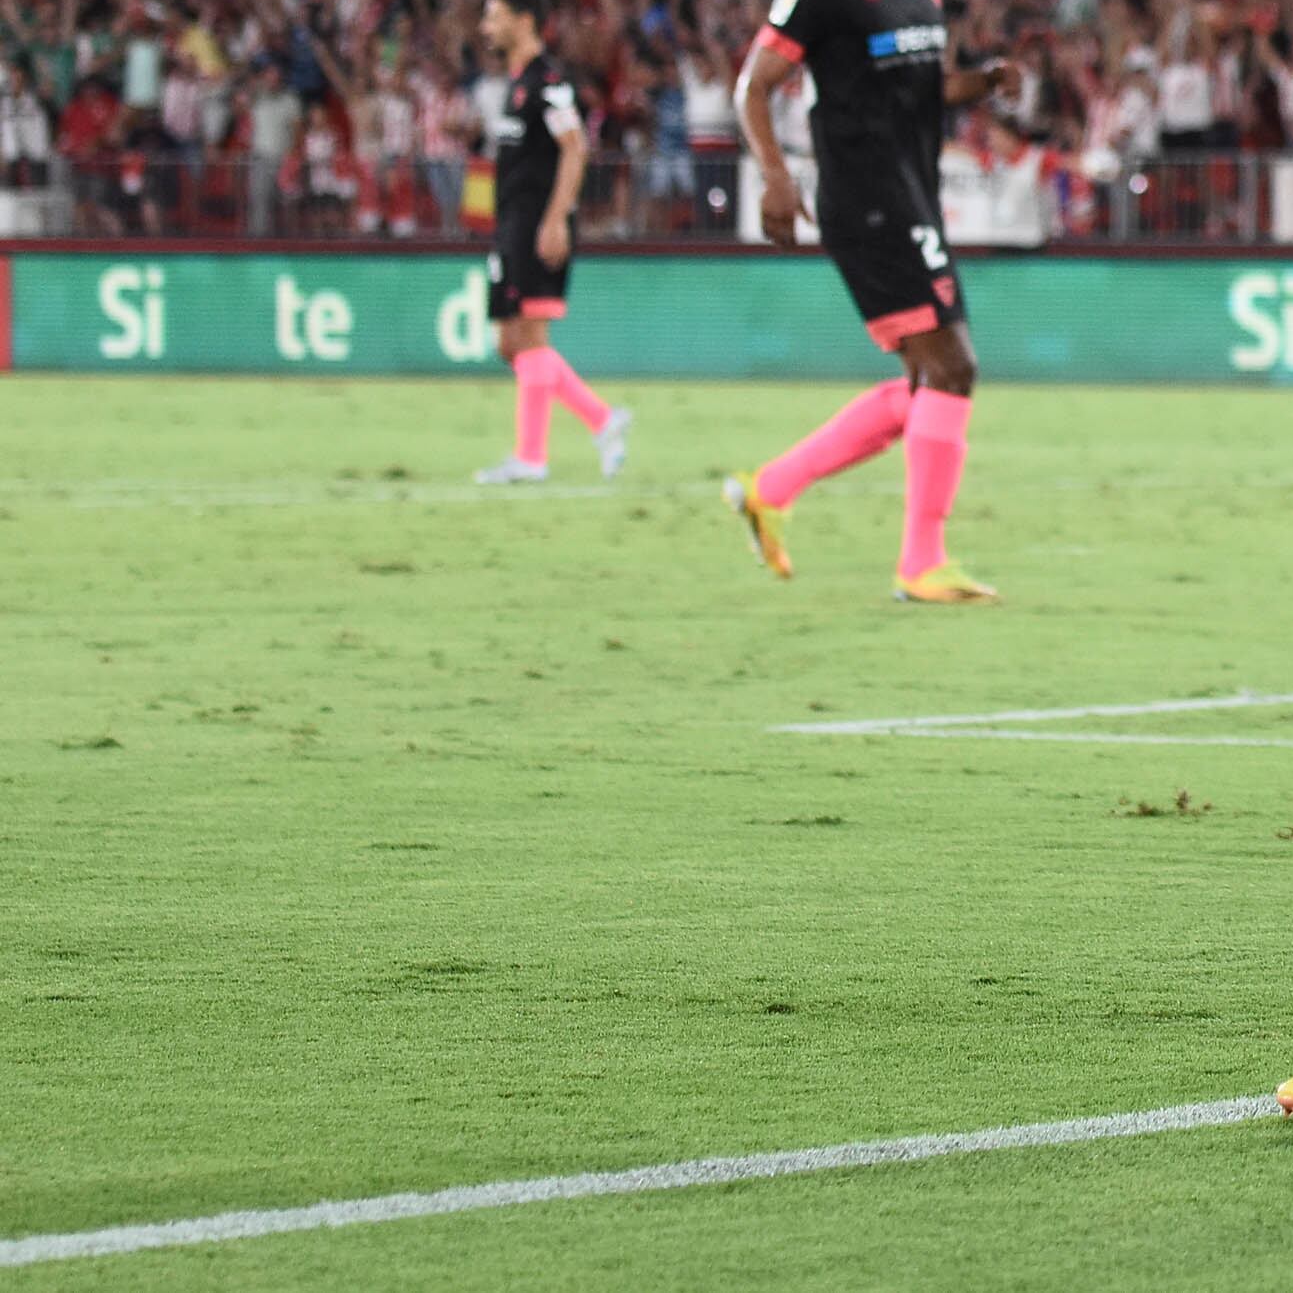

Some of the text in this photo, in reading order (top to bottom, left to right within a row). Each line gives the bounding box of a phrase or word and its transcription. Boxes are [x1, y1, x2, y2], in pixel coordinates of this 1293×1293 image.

[99, 263, 499, 362] Si te d
